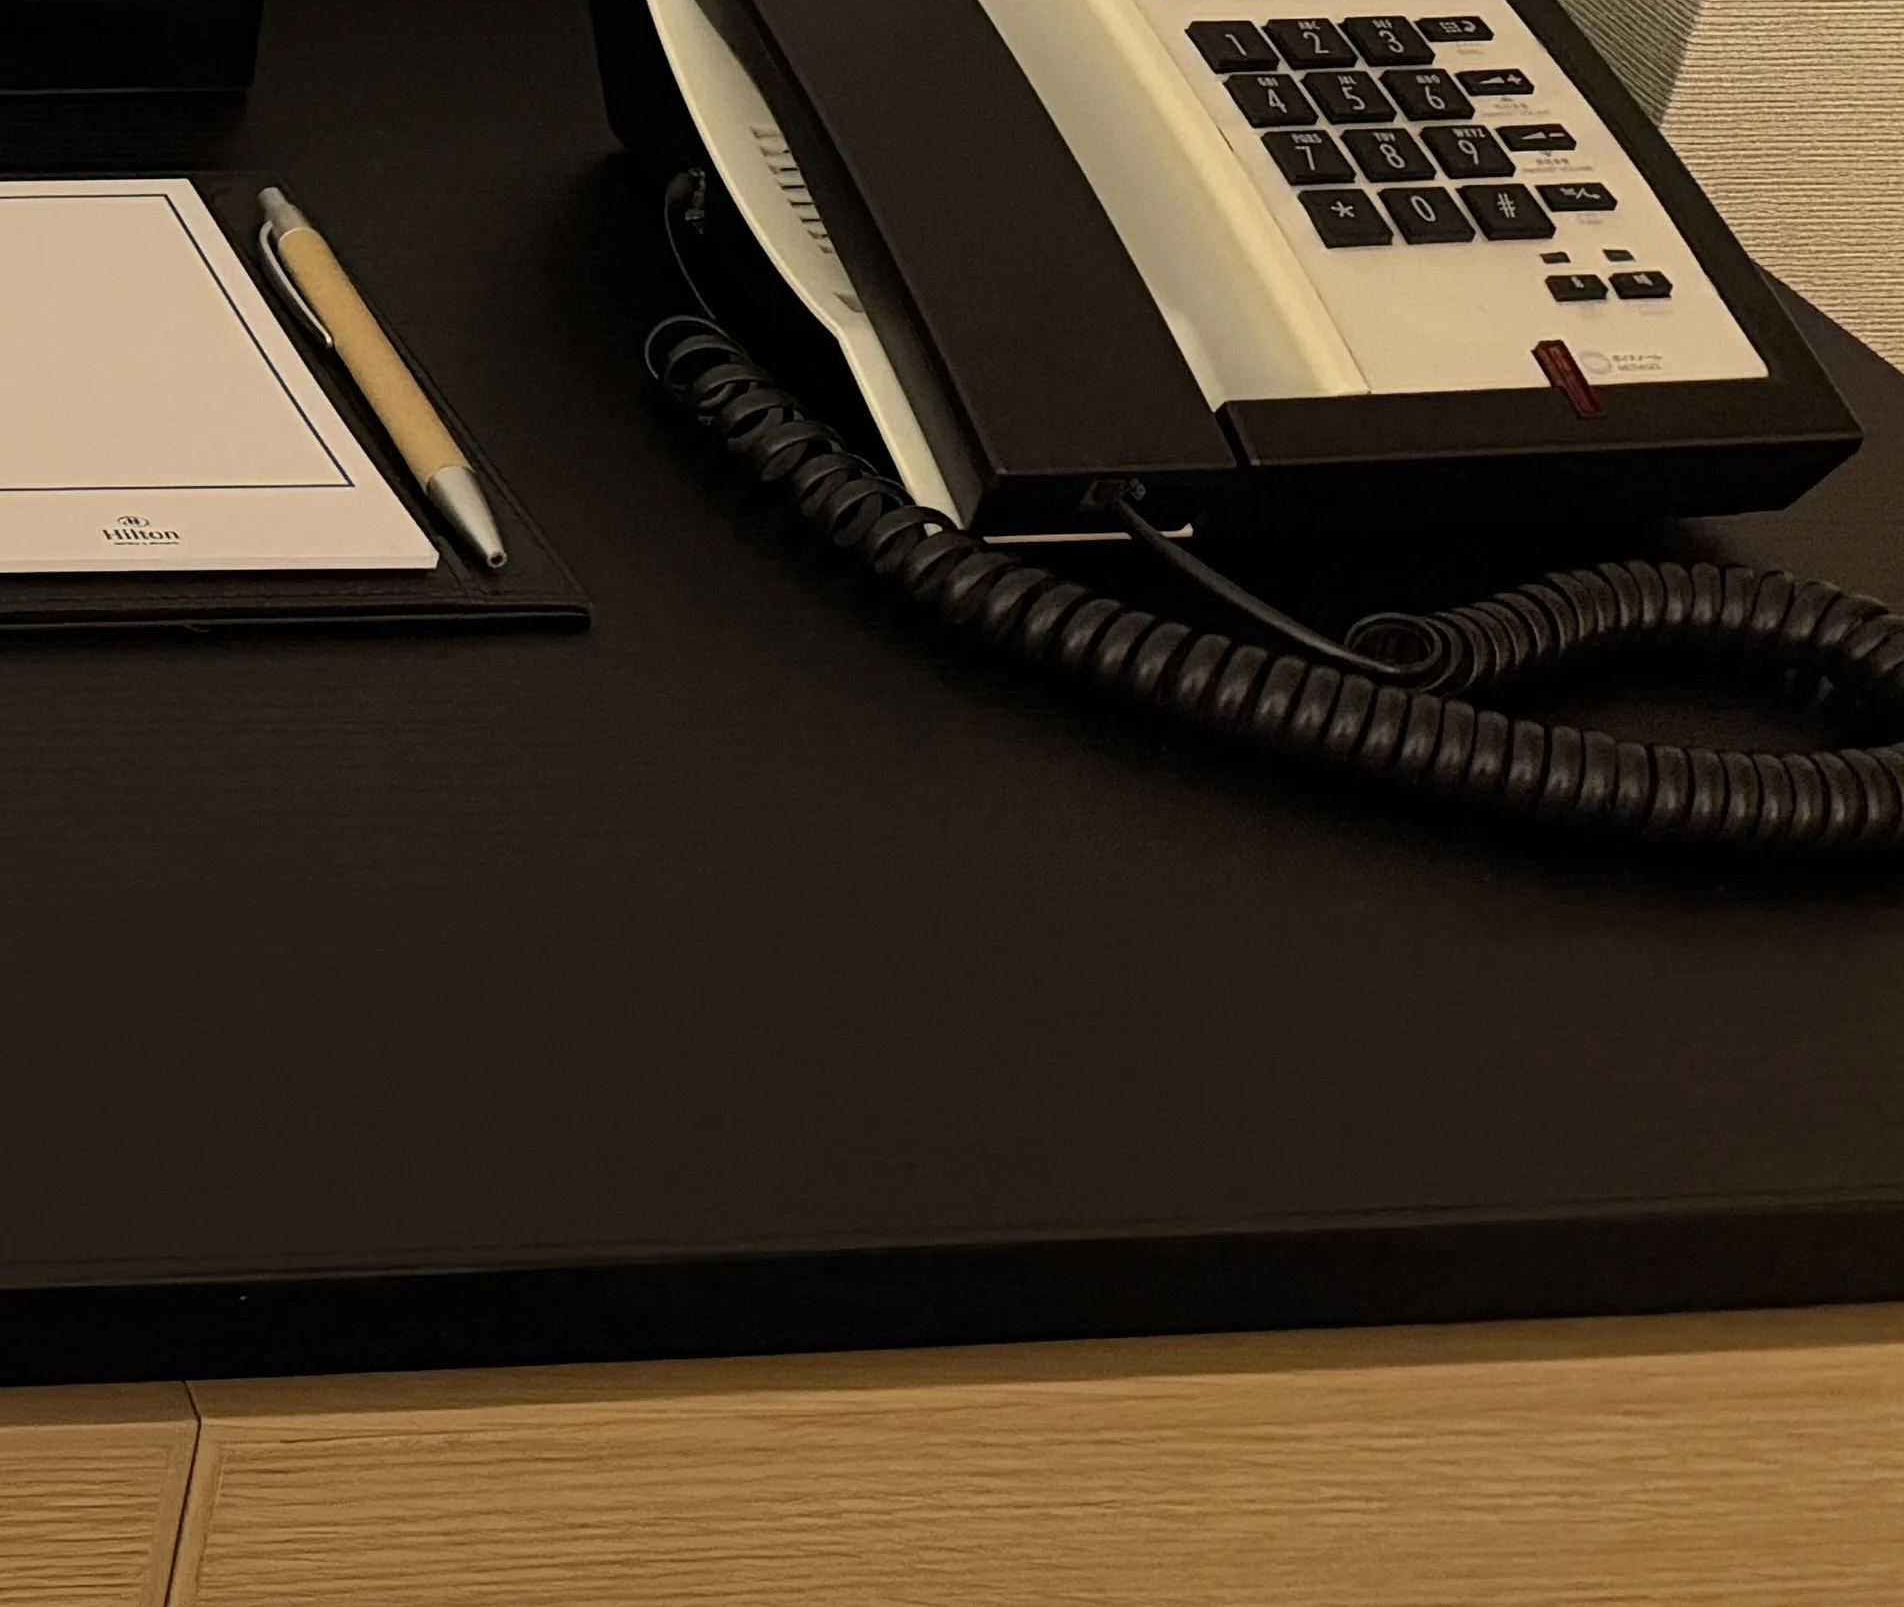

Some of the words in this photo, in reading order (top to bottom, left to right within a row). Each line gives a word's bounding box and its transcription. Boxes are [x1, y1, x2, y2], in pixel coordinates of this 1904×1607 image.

[1225, 33, 1247, 56] 1
[1302, 31, 1329, 54] 2
[1378, 30, 1404, 53] 3
[1267, 88, 1288, 113] 4
[1341, 86, 1366, 110] 5
[1424, 85, 1446, 110] 6
[1295, 145, 1316, 171] 7
[1379, 143, 1406, 169] 8
[1457, 139, 1479, 165] 9
[1410, 195, 1436, 222] 0
[102, 528, 180, 540] Hilton
